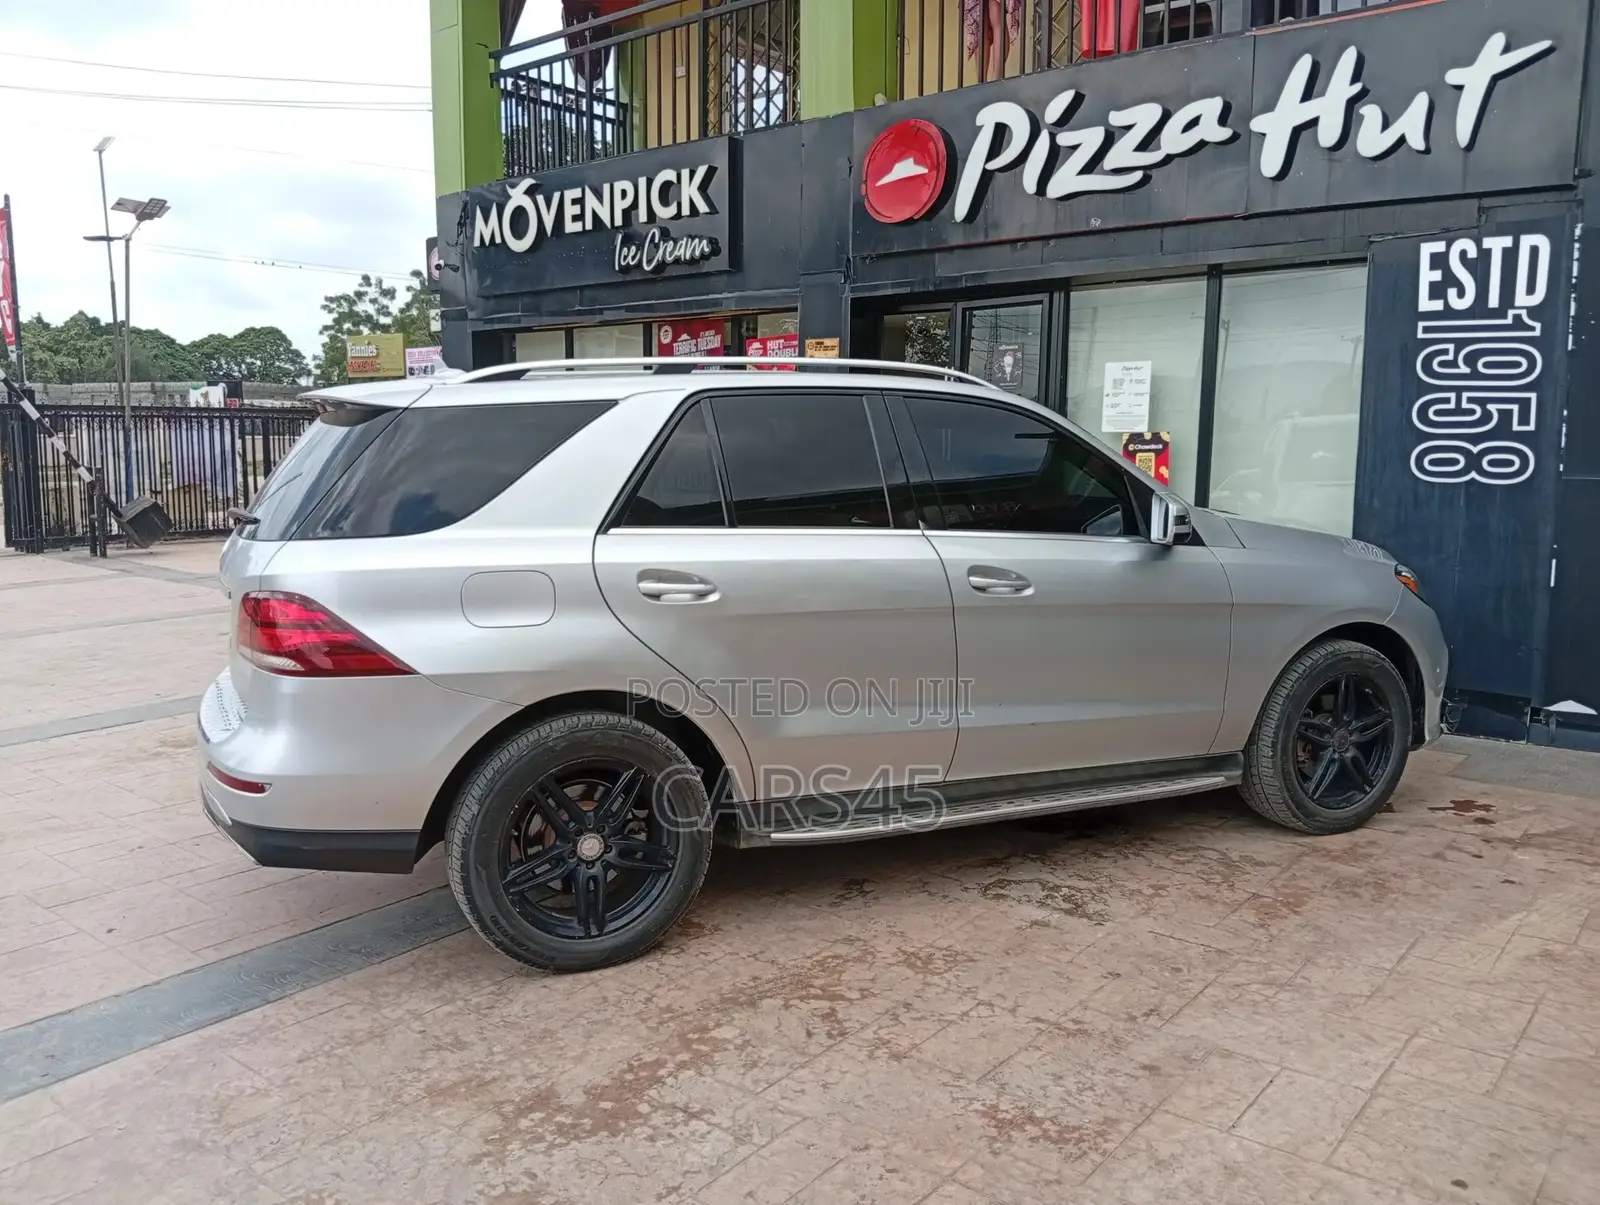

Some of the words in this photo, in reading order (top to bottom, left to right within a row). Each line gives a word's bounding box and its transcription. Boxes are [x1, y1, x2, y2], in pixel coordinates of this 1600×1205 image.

[954, 88, 1236, 224] Pizza
[1249, 31, 1554, 180] Hut
[614, 230, 642, 271] Ice
[643, 228, 711, 272] Cream
[1418, 233, 1552, 312] ESTD
[697, 334, 722, 351] TUESDAY
[766, 339, 784, 350] HUT
[1410, 309, 1543, 485] 1958
